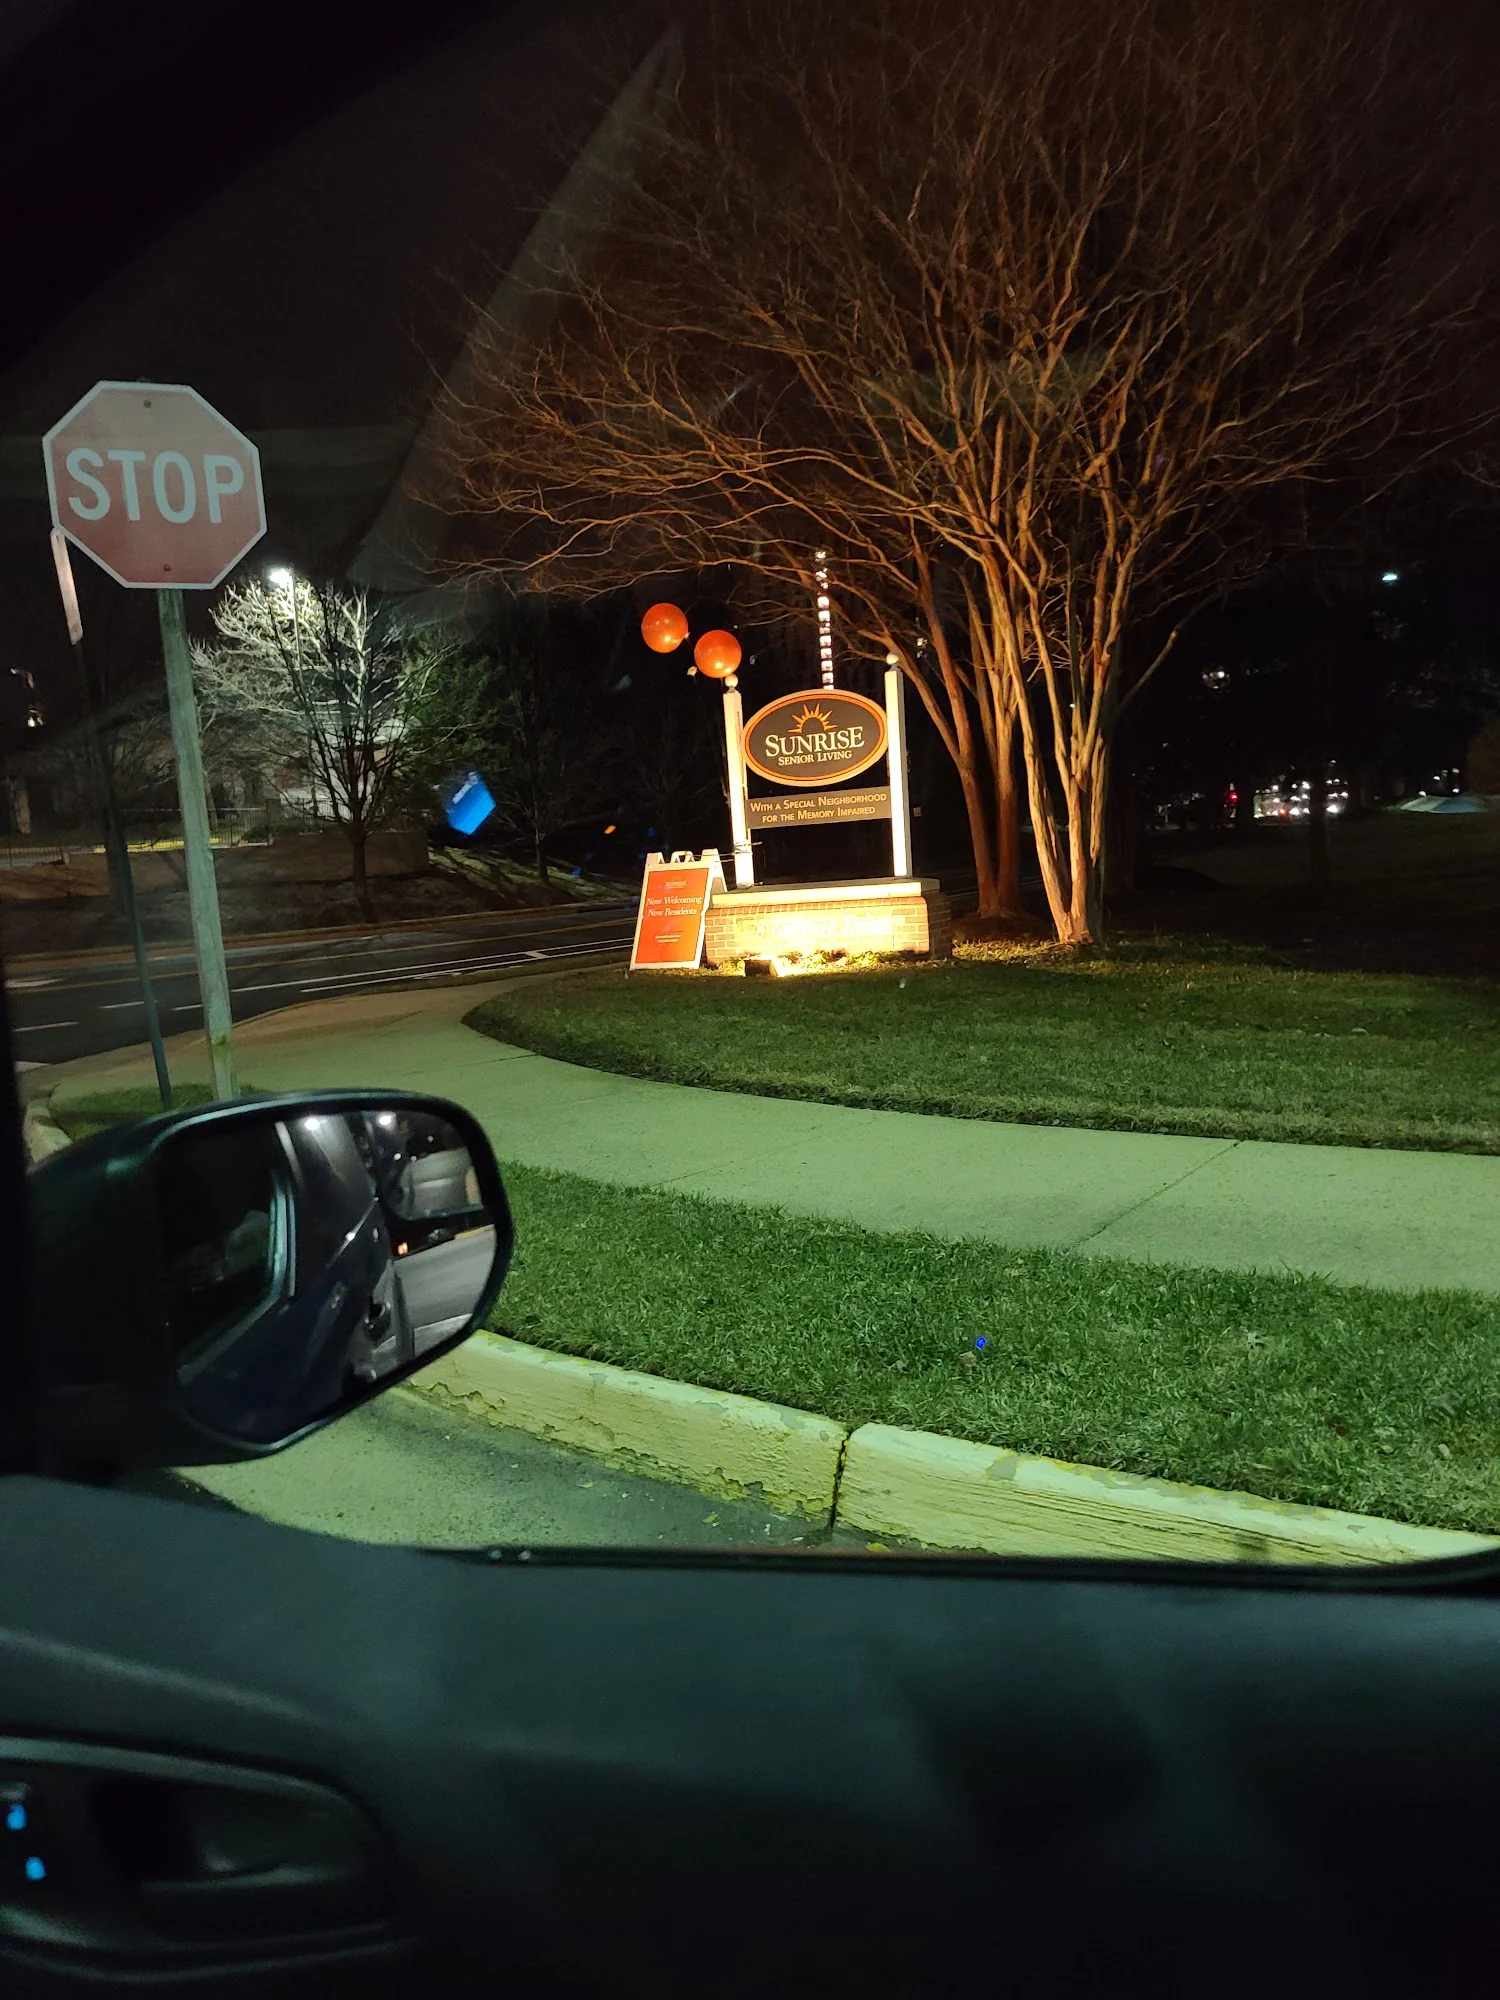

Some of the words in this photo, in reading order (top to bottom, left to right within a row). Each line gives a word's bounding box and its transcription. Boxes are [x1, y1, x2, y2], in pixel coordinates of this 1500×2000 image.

[66, 447, 245, 524] STOP
[765, 726, 865, 757] SUNRISE
[778, 754, 814, 766] SENIOR
[817, 750, 853, 762] LIVING
[750, 802, 773, 812] WITH
[774, 802, 781, 810] A
[783, 797, 816, 809] SPECIAL
[818, 793, 887, 807] NEIGHBORHOOD
[762, 815, 778, 823] FOR
[780, 813, 795, 821] THE
[797, 809, 835, 820] MEMORY
[837, 806, 876, 817] IMPAIRED
[664, 896, 703, 905] Welcoming
[648, 909, 663, 917] New
[664, 907, 697, 916] Residents
